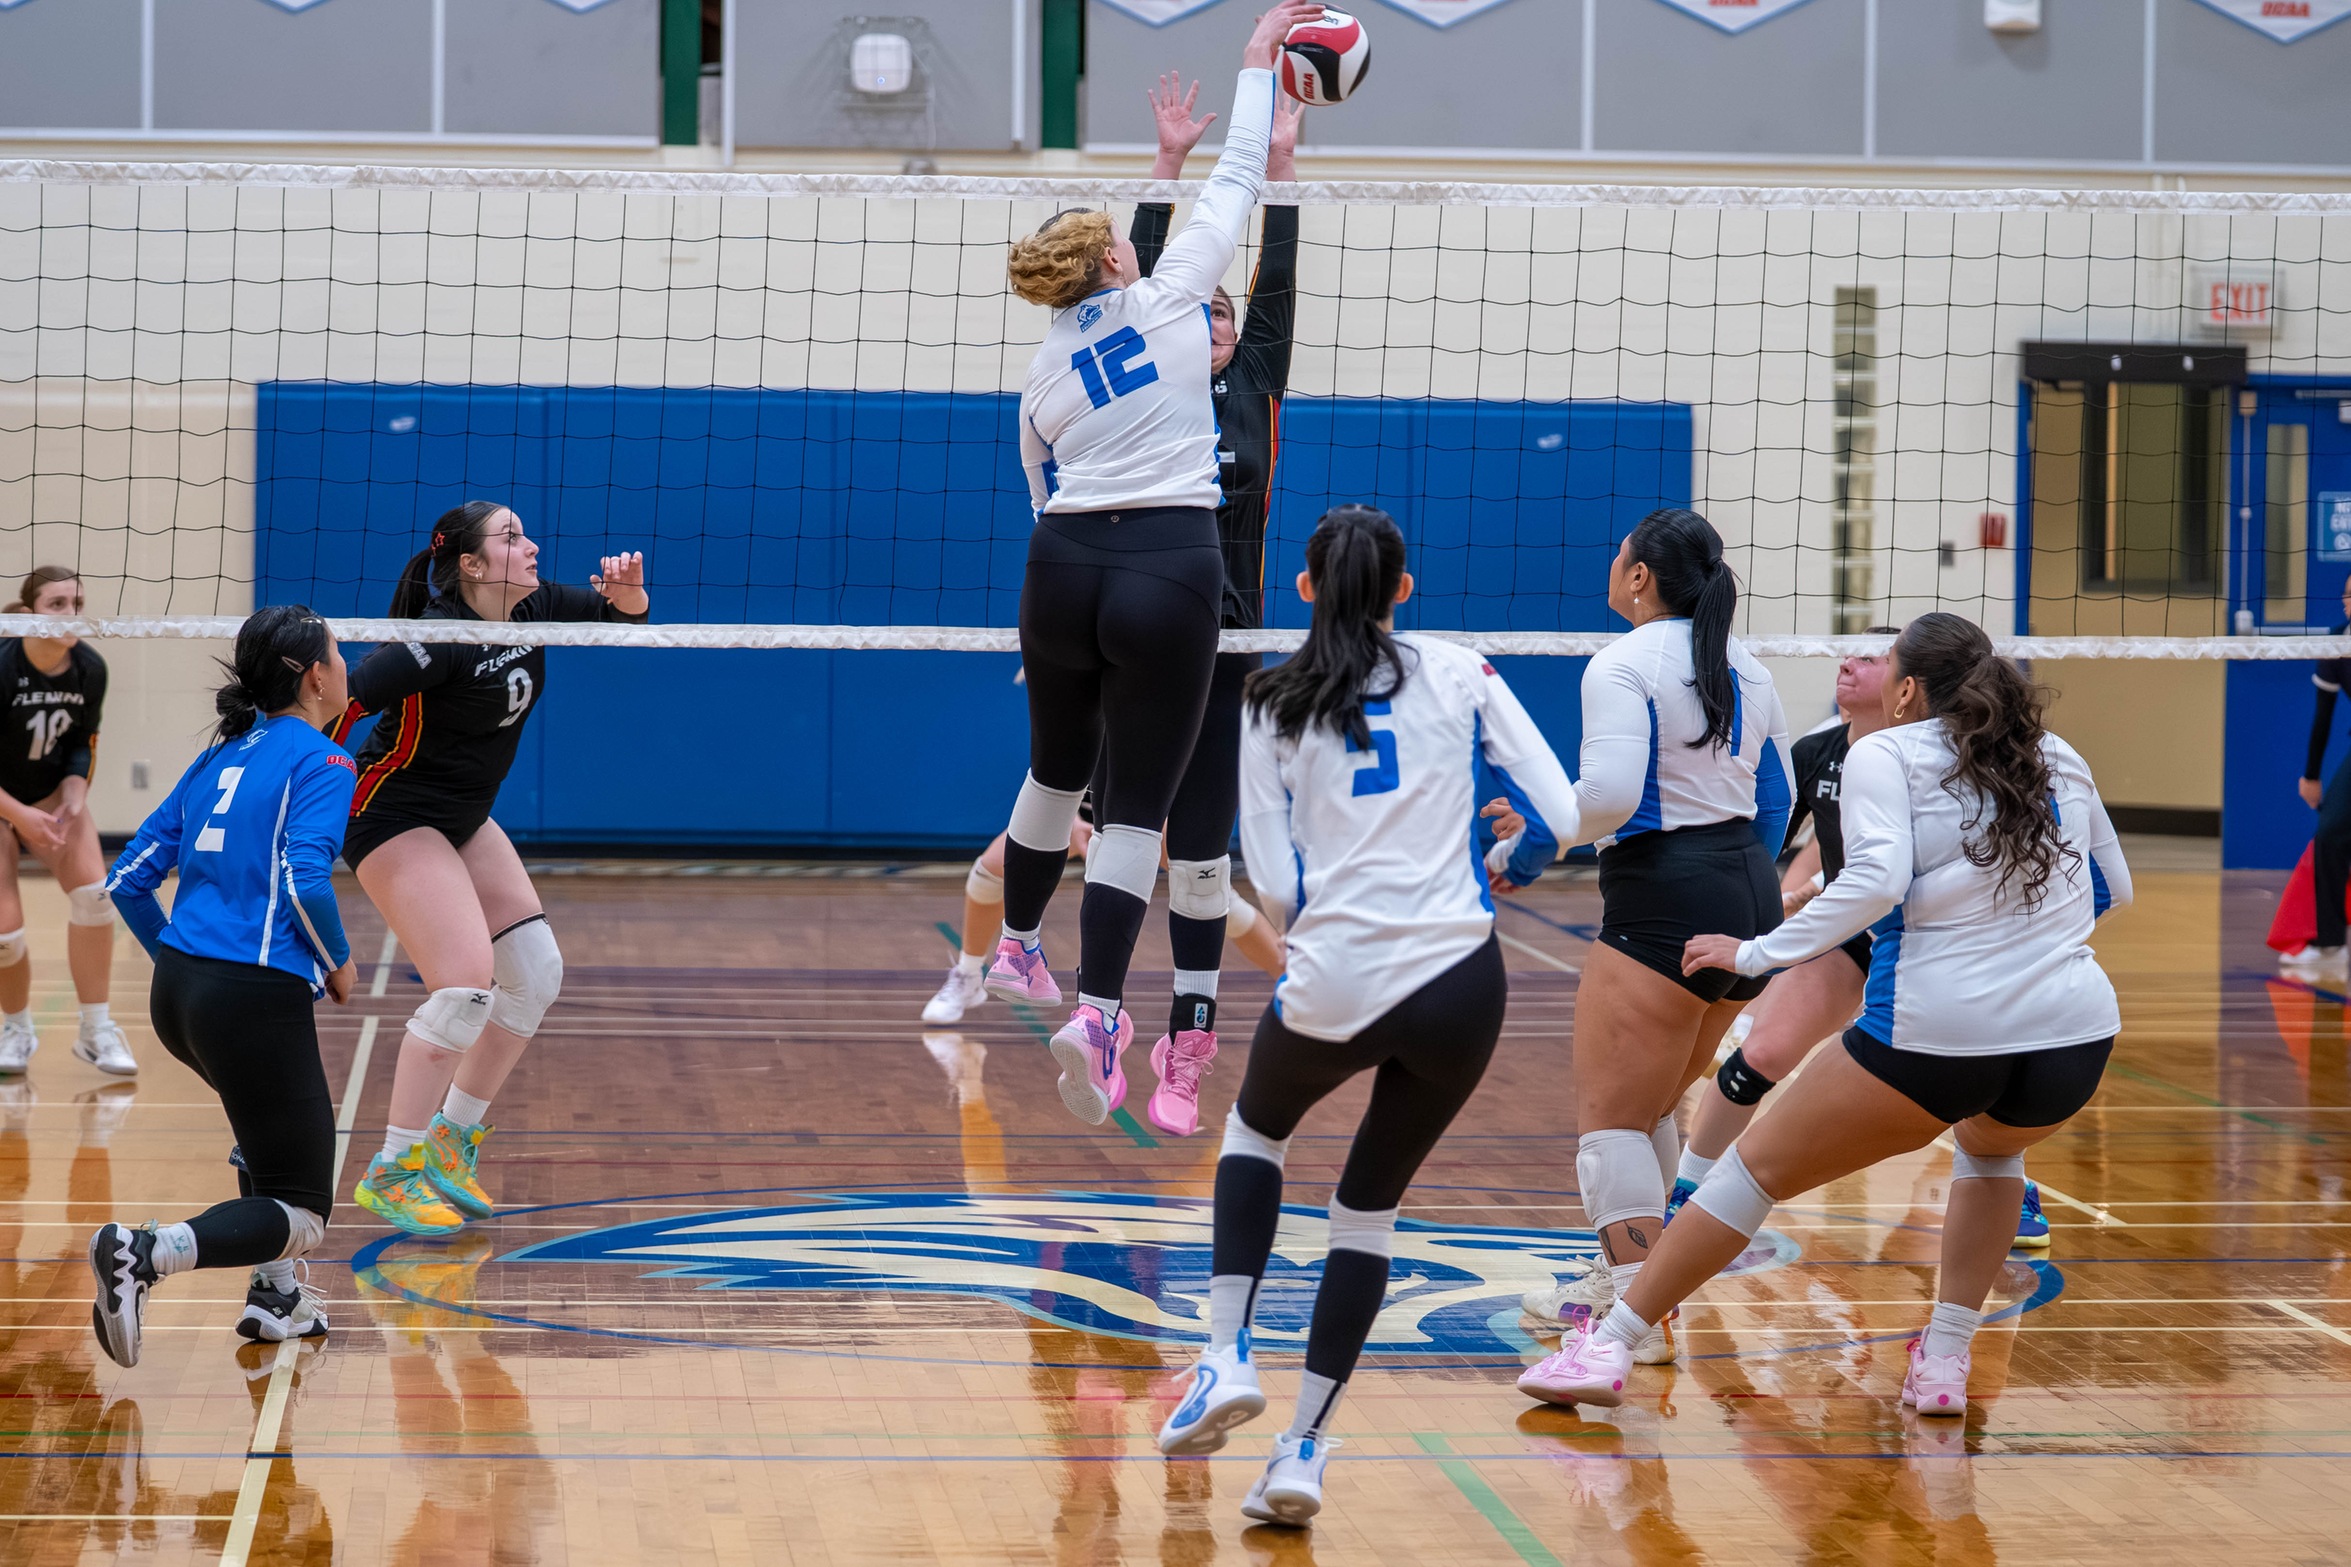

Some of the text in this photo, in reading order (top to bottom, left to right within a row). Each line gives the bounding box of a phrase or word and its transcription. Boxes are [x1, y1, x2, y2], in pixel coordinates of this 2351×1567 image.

[2210, 282, 2271, 321] EXIT
[1071, 325, 1159, 410] 12
[499, 667, 533, 727] 9
[326, 755, 358, 776] OCA
[1345, 690, 1399, 797] 5
[195, 765, 245, 852] 2
